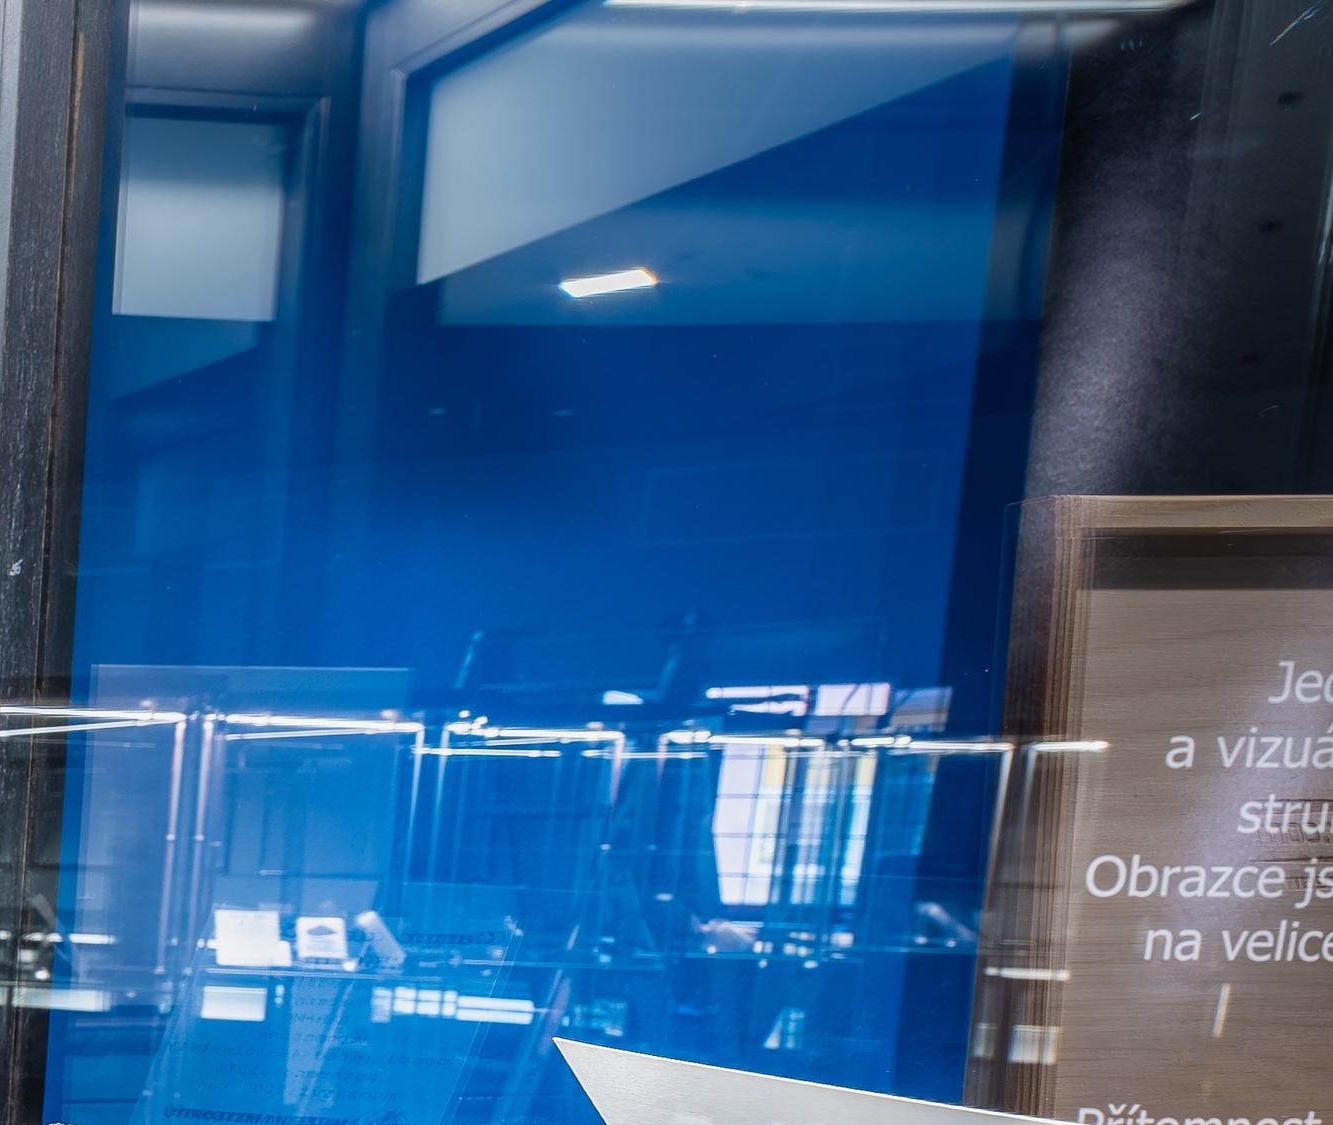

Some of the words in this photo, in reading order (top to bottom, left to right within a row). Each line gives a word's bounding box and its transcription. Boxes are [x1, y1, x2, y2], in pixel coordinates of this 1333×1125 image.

[1165, 735, 1195, 769] a
[1085, 855, 1285, 898] Obrazce
[1143, 927, 1202, 962] na
